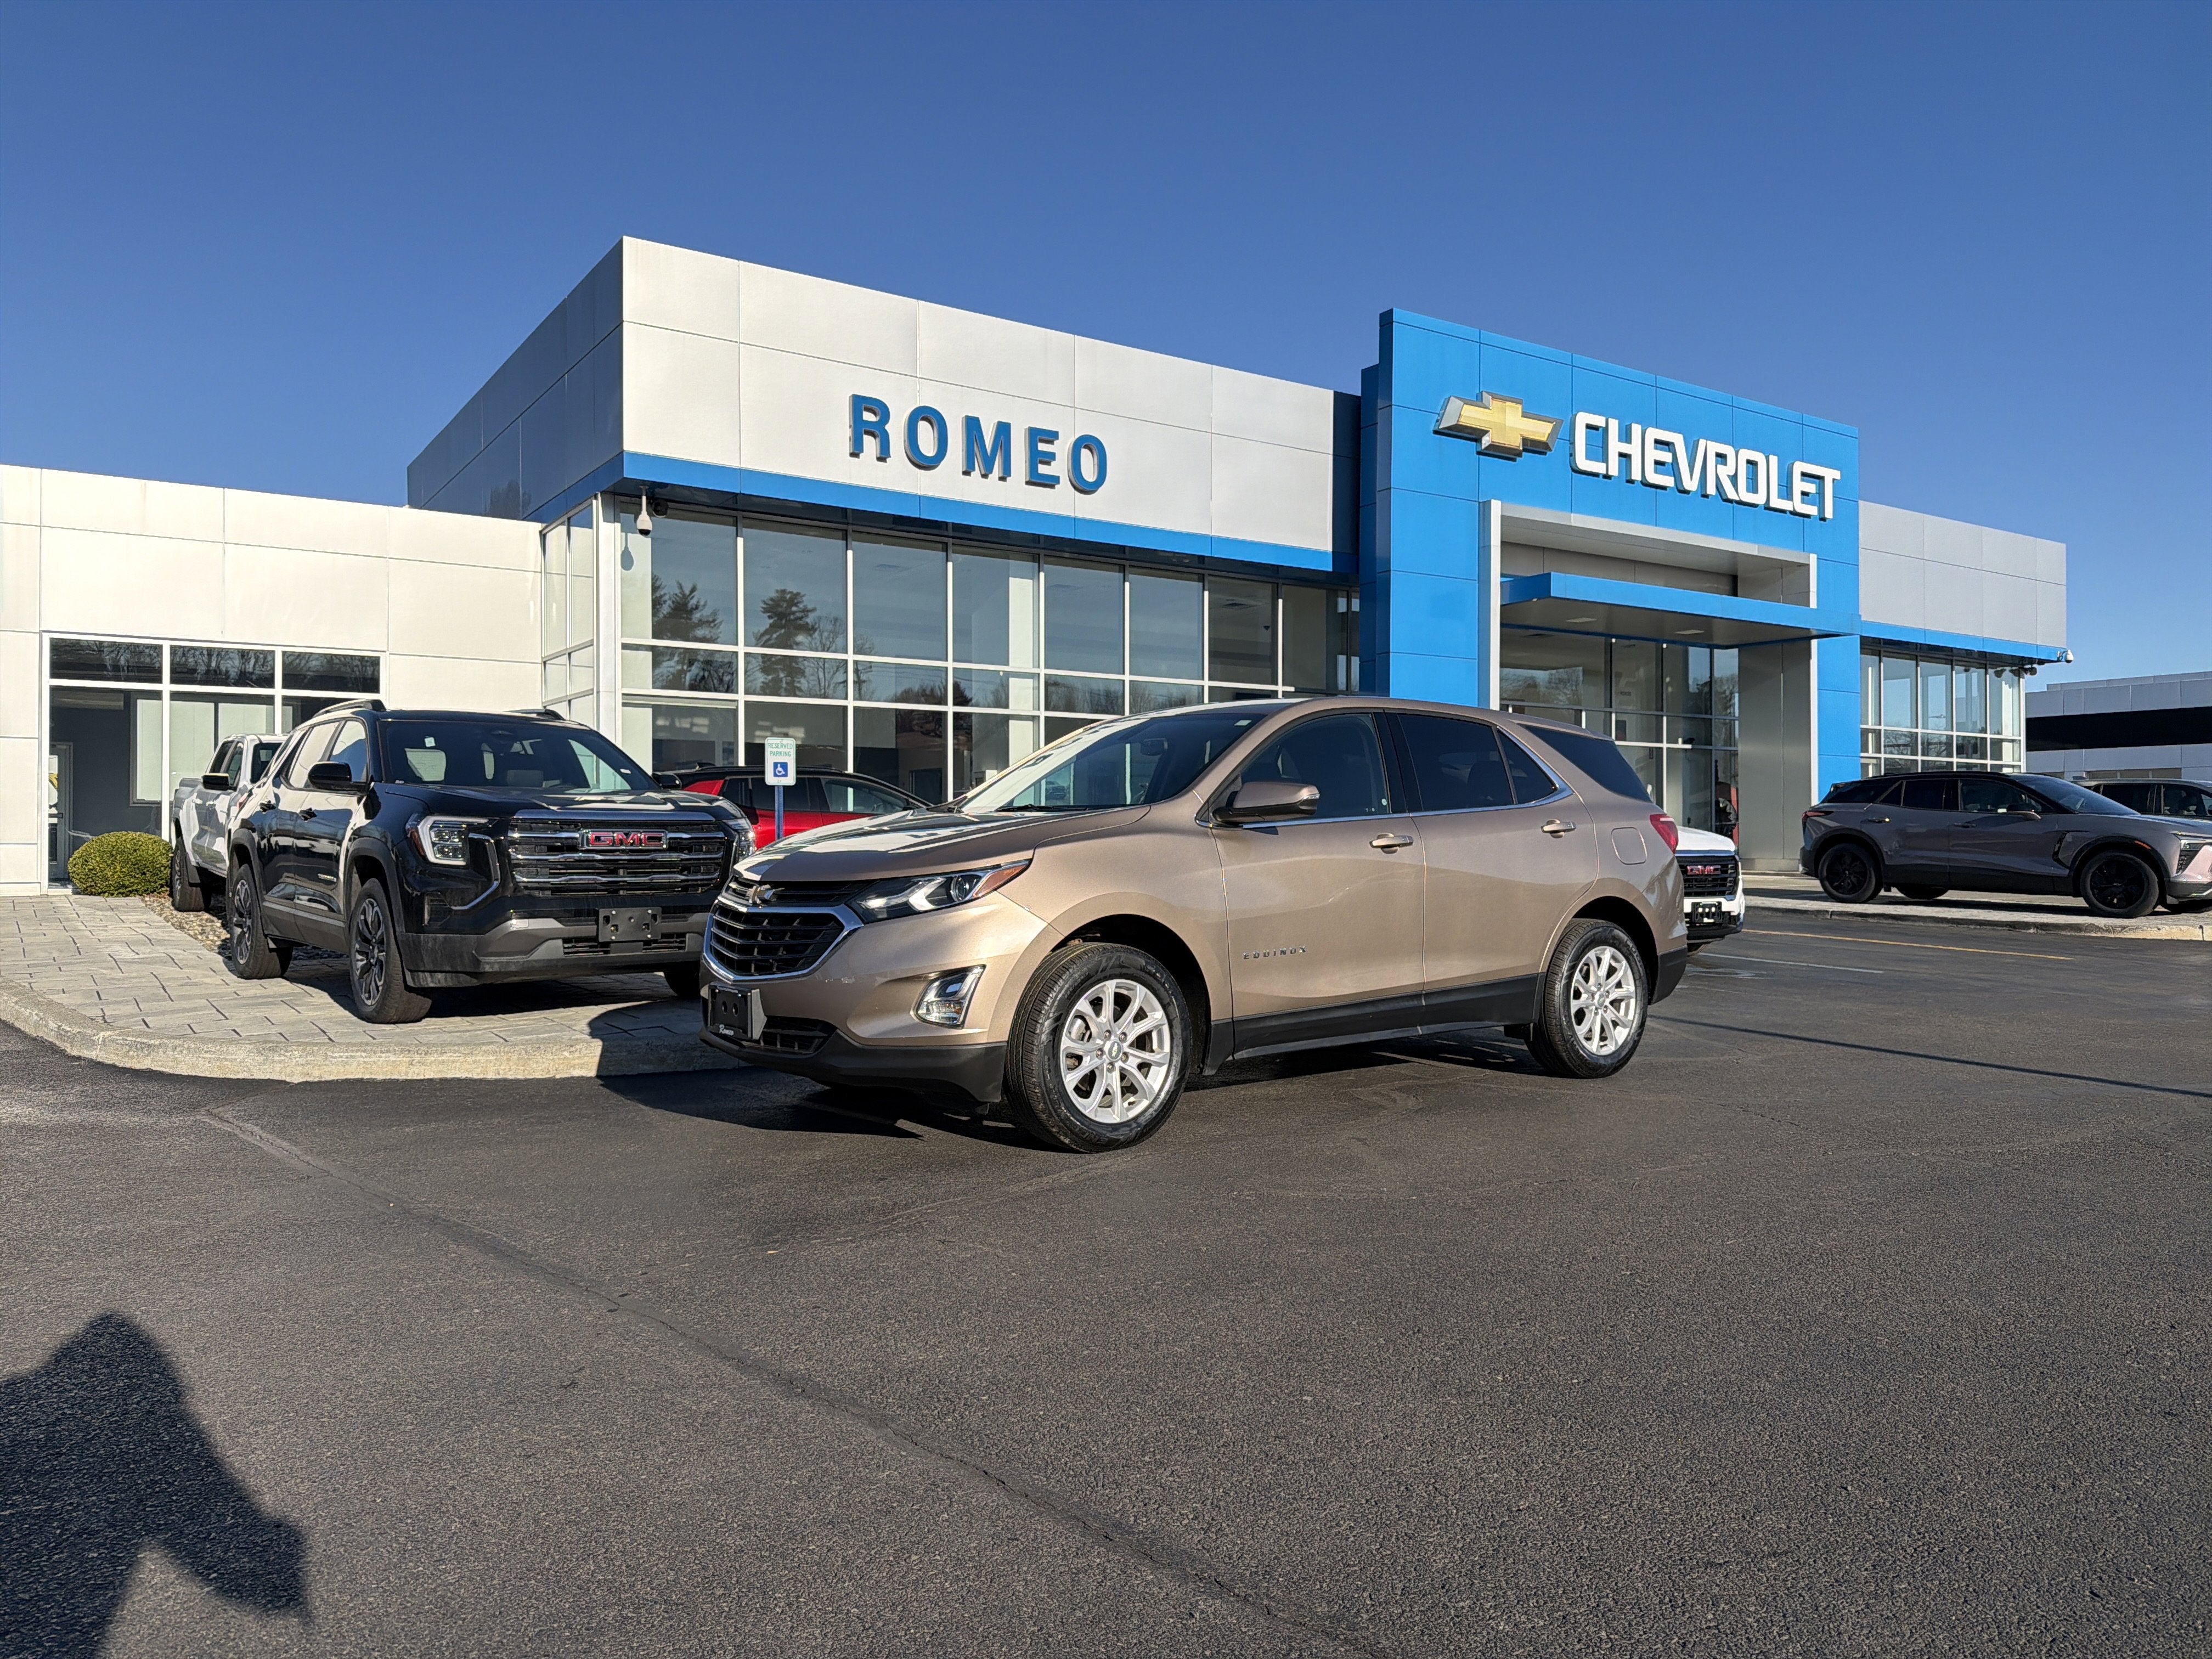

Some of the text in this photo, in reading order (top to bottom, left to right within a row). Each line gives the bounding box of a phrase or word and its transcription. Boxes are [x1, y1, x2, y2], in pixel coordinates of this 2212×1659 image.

[849, 393, 1108, 494] ROMEO
[1572, 411, 1841, 520] CHEVROLET
[589, 832, 664, 847] GMC
[1686, 865, 1722, 875] GMC
[1243, 945, 1306, 960] EQUINOX
